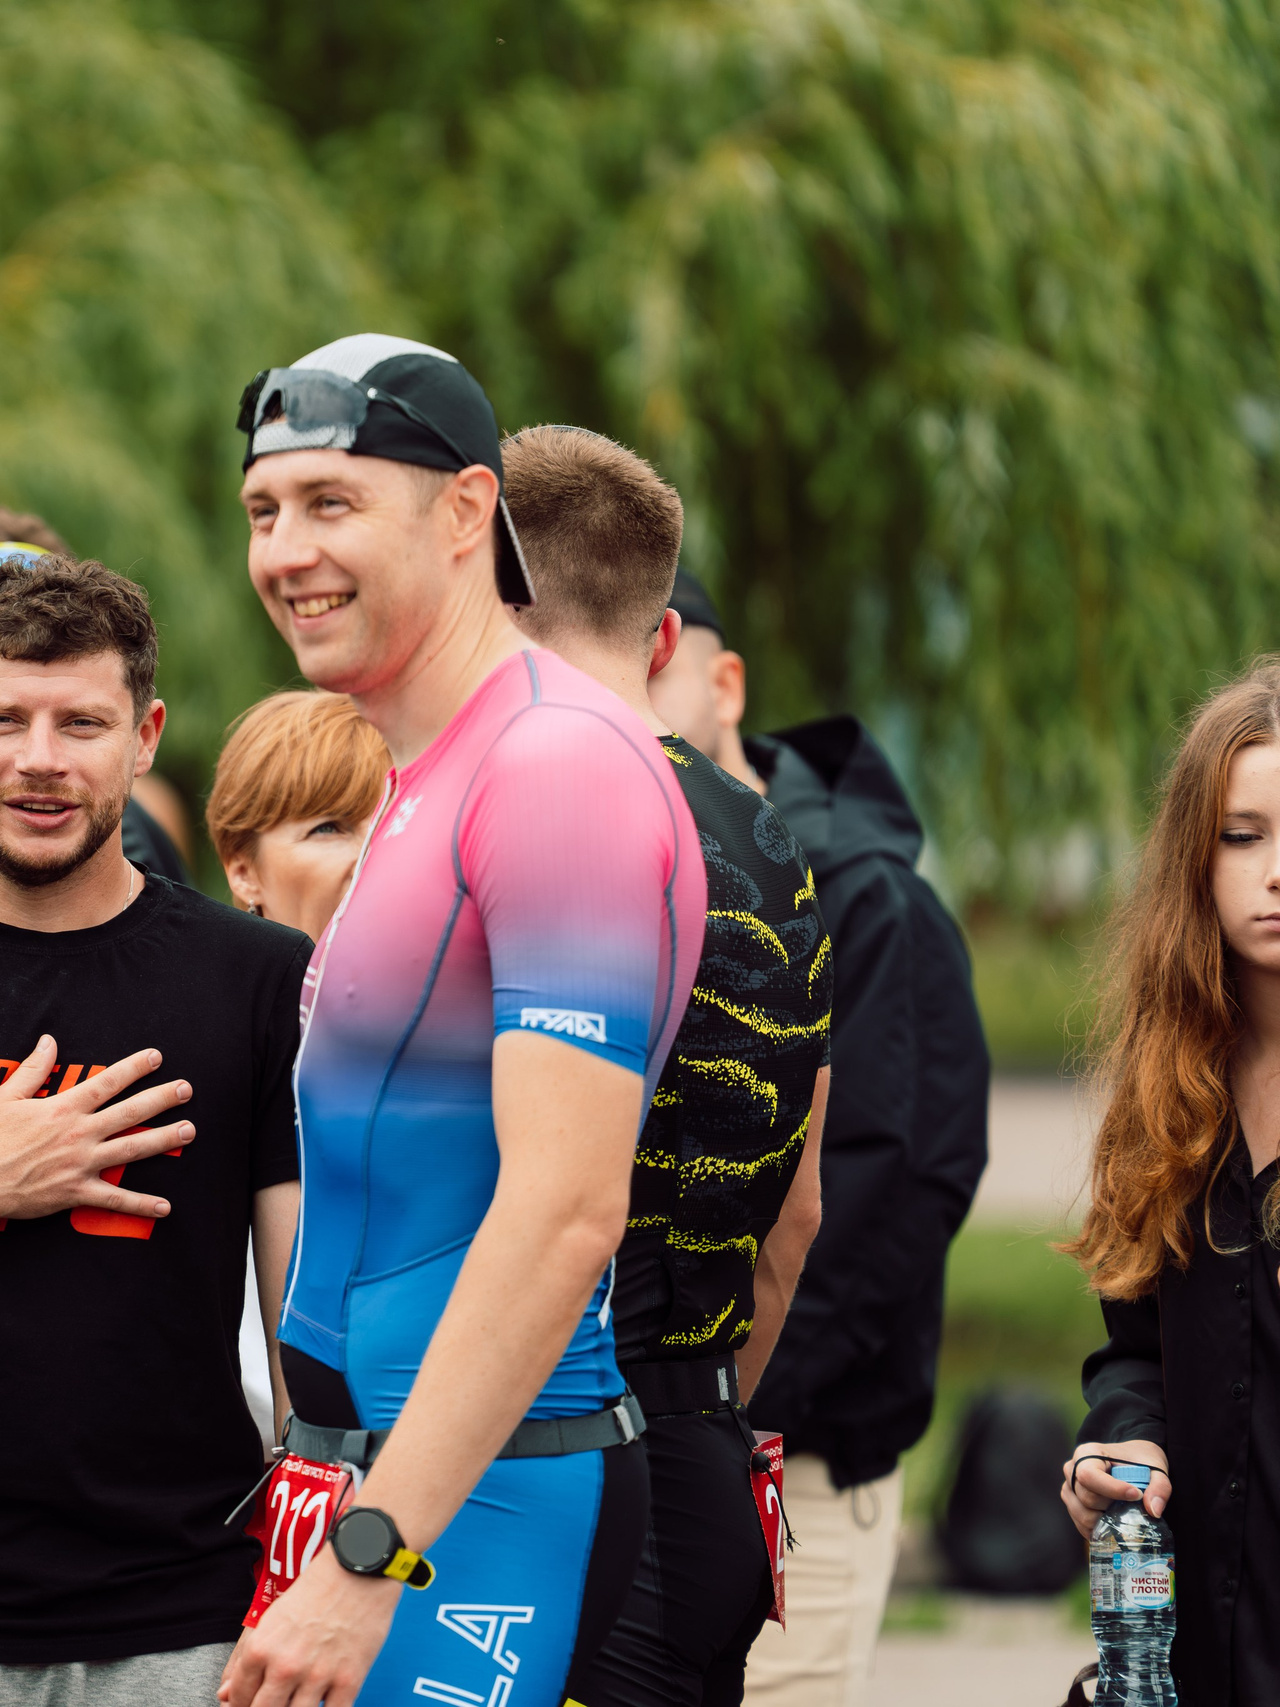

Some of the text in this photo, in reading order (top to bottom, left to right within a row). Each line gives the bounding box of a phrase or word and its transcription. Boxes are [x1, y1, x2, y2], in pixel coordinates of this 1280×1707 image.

[270, 1480, 331, 1580] 212
[1131, 1574, 1170, 1586] ЧИСТЫЙ
[1131, 1586, 1170, 1595] ГЛОТОК
